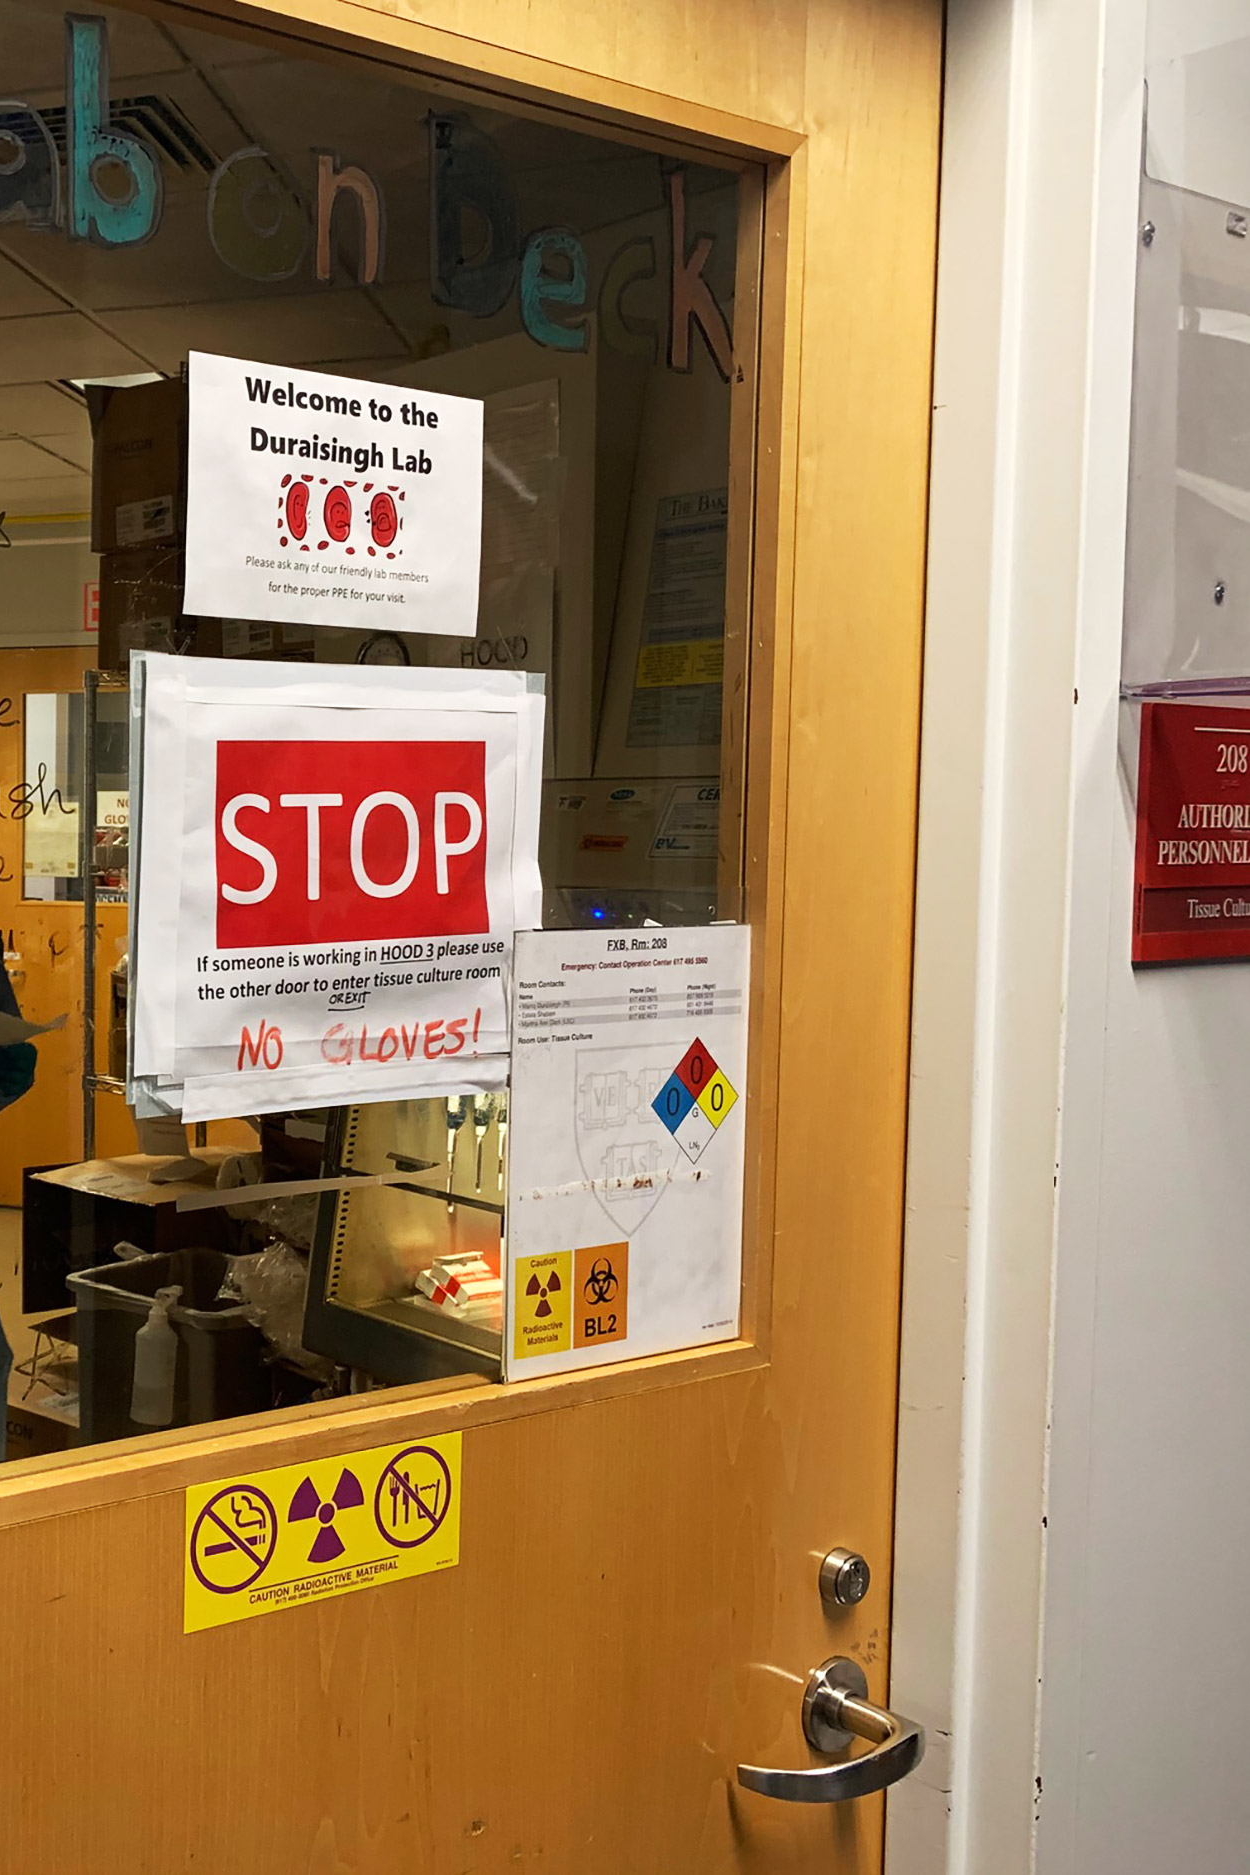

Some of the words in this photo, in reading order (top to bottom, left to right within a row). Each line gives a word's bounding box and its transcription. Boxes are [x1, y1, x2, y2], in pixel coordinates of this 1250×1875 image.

[207, 145, 382, 284] on
[427, 108, 733, 382] Deck
[245, 376, 362, 417] Welcome
[368, 399, 393, 423] to
[400, 402, 439, 429] the
[250, 426, 384, 473] Duraisingh
[392, 447, 432, 475] Lab
[245, 555, 275, 570] Please
[277, 557, 292, 571] ask
[294, 561, 310, 575] any
[311, 561, 320, 573] of
[321, 564, 338, 575] our
[339, 563, 373, 581] friendly
[374, 566, 387, 580] lab
[389, 569, 430, 584] members
[268, 581, 281, 593] for
[283, 582, 298, 595] the
[300, 586, 330, 601] proper
[332, 586, 348, 598] PPE
[350, 587, 363, 600] for
[365, 590, 385, 604] your
[387, 591, 406, 604] visit.
[1216, 744, 1248, 773] 208
[221, 790, 483, 905] STOP
[1157, 839, 1250, 866] PERSONNEL
[1187, 898, 1221, 919] Tissue
[197, 955, 209, 973] If
[212, 952, 285, 972] someone
[288, 951, 300, 968] is
[303, 948, 361, 971] working
[364, 946, 377, 963] in
[380, 943, 423, 963] HOOD
[426, 942, 434, 960] 3
[436, 941, 479, 963] please
[481, 939, 504, 954] use
[607, 940, 628, 952] FXB,
[631, 939, 650, 950] Rm:
[561, 963, 597, 972] Emergency:
[598, 961, 622, 970] Contact
[623, 959, 652, 970] Operation
[652, 958, 672, 967] Center
[197, 983, 225, 1001] the
[229, 980, 271, 1000] other
[275, 978, 310, 997] door
[313, 976, 329, 992] to
[332, 975, 370, 991] enter
[374, 971, 414, 988] tissue
[416, 967, 463, 987] culture
[466, 966, 501, 980] room
[519, 981, 537, 989] Room
[538, 979, 566, 989] Contacts:
[329, 992, 346, 1006] OR
[346, 990, 370, 1005] EXIT
[237, 1018, 284, 1071] NO
[320, 1007, 482, 1066] GLOVES!
[518, 1037, 535, 1045] Room
[551, 1034, 570, 1042] Tissue
[571, 1033, 593, 1042] Culture
[690, 1056, 703, 1085] 0
[667, 1087, 680, 1116] 0
[711, 1084, 724, 1111] 0
[530, 1257, 557, 1268] Caution
[523, 1321, 563, 1336] Radioactive
[584, 1314, 617, 1337] BL2
[527, 1334, 559, 1346] Materials
[249, 1587, 290, 1604] CAUTION
[293, 1572, 352, 1593] RADIOACTIVE
[356, 1561, 398, 1577] MATERIAL
